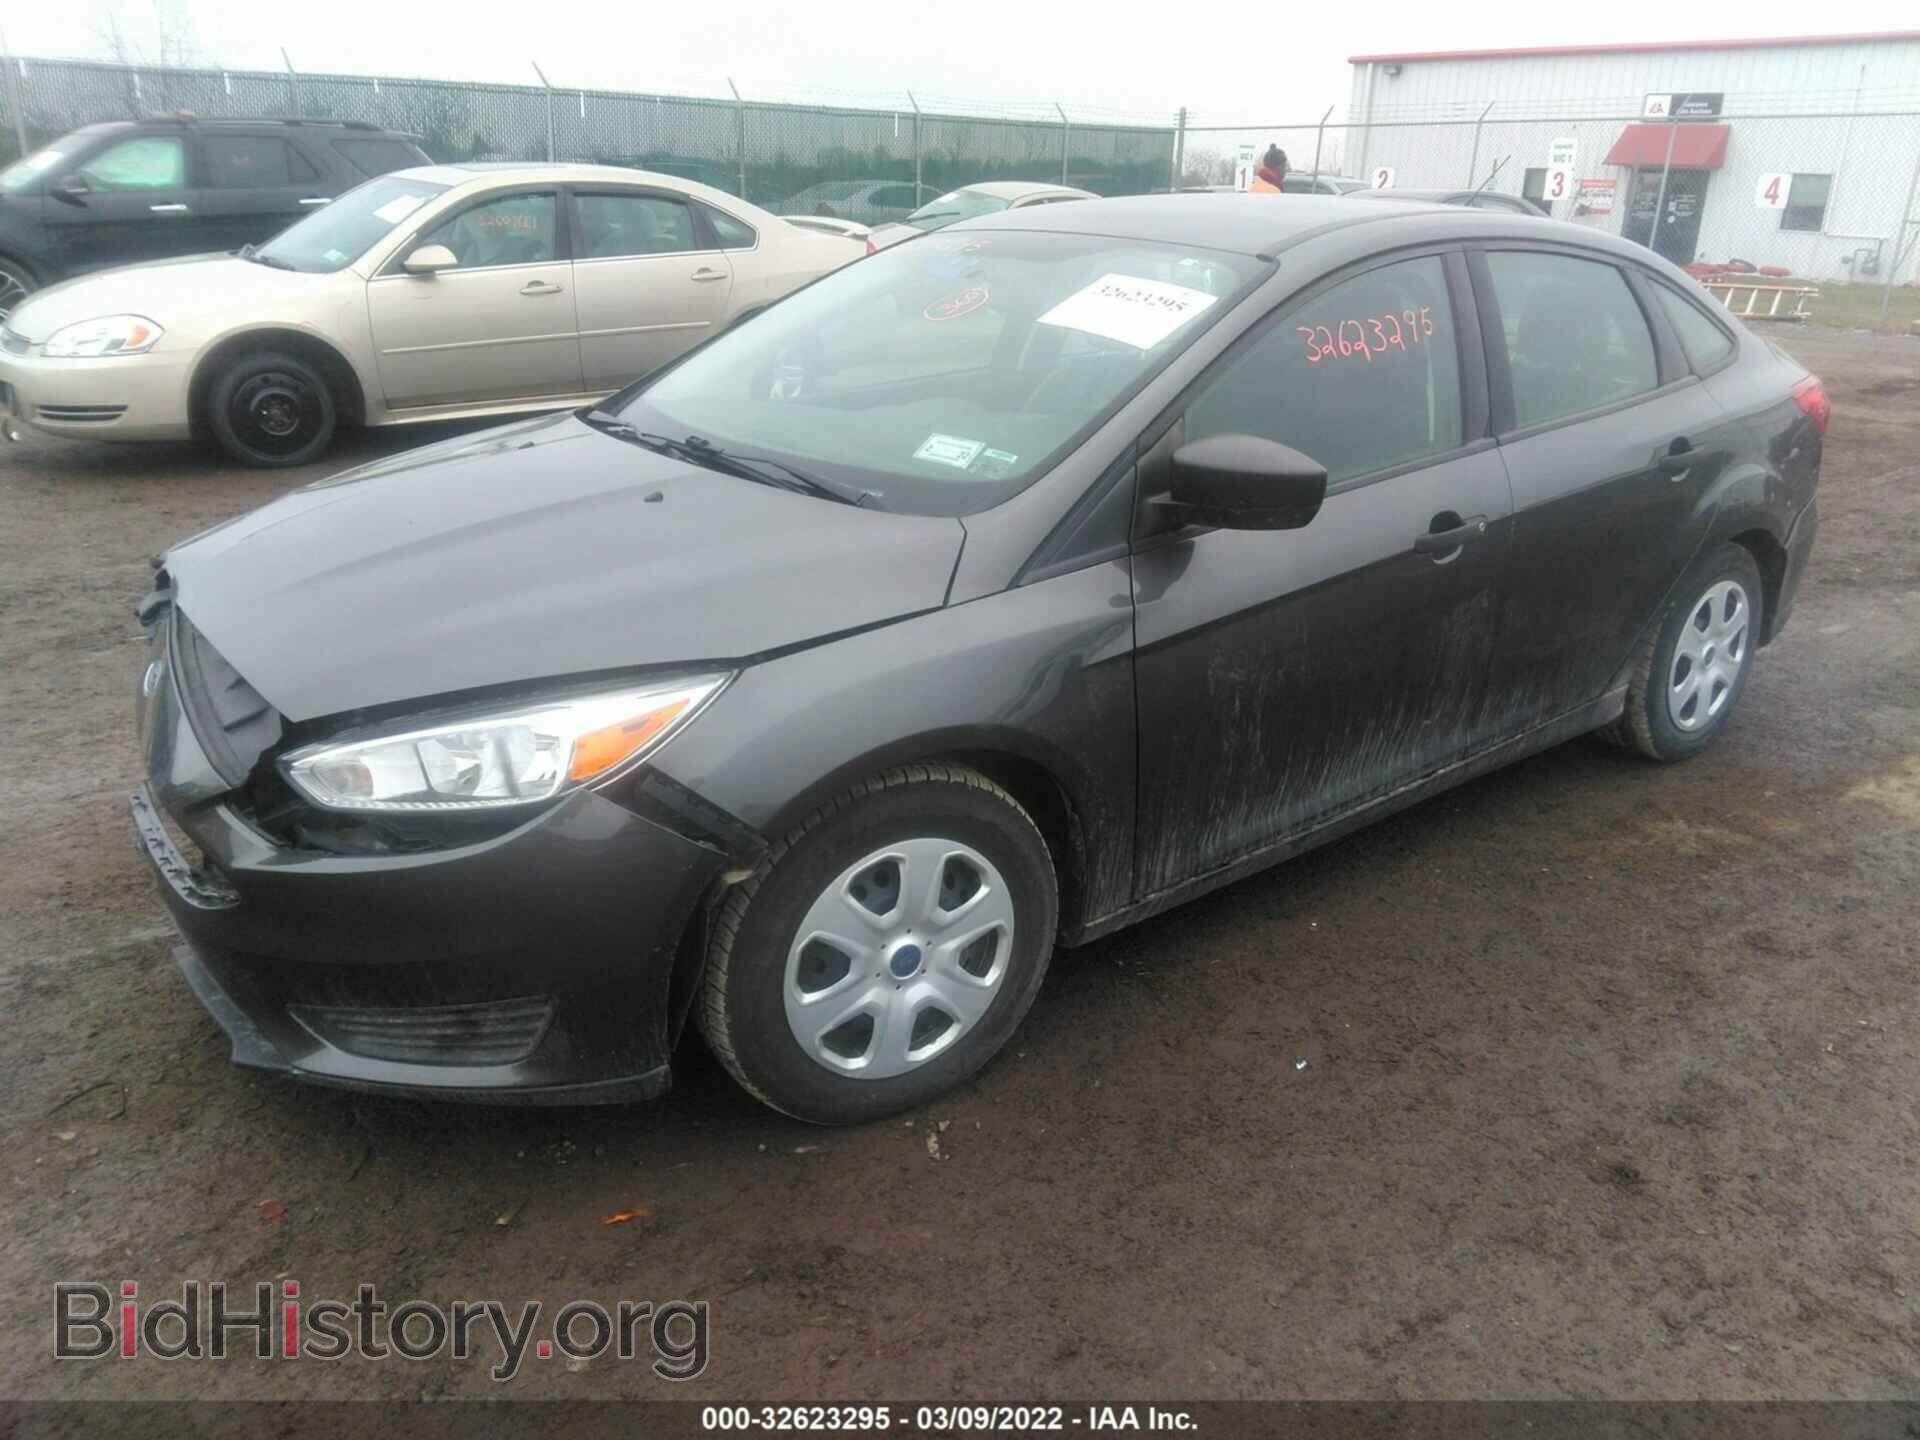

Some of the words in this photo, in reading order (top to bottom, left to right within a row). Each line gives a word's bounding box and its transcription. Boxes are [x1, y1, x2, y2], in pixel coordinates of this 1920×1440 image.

[1240, 167, 1247, 189] 1
[1377, 169, 1390, 189] 2
[1551, 171, 1565, 198] 3
[1763, 176, 1781, 205] 4
[1296, 305, 1434, 363] 32623295
